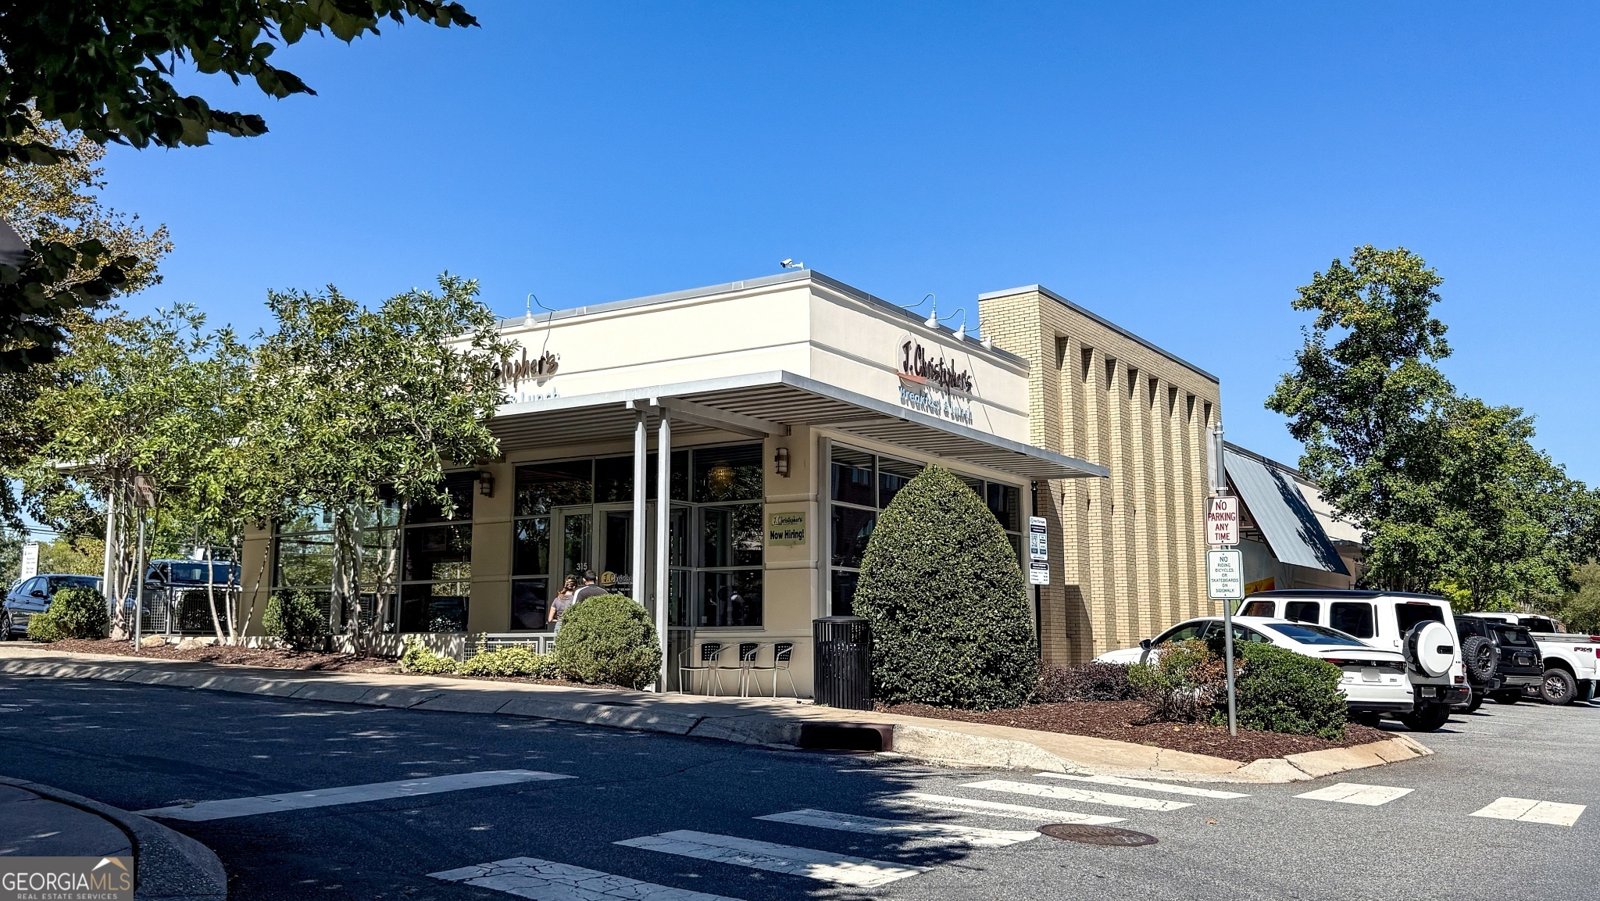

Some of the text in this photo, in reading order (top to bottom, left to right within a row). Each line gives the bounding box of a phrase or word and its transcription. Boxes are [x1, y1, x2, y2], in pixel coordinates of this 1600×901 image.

[902, 340, 972, 396] J. Christopher's
[1215, 501, 1227, 511] NO
[1208, 512, 1236, 521] PARKING
[1215, 523, 1229, 531] ANY
[770, 529, 805, 541] Now Hiring!
[1215, 533, 1230, 541] TIME
[576, 562, 588, 571] 315
